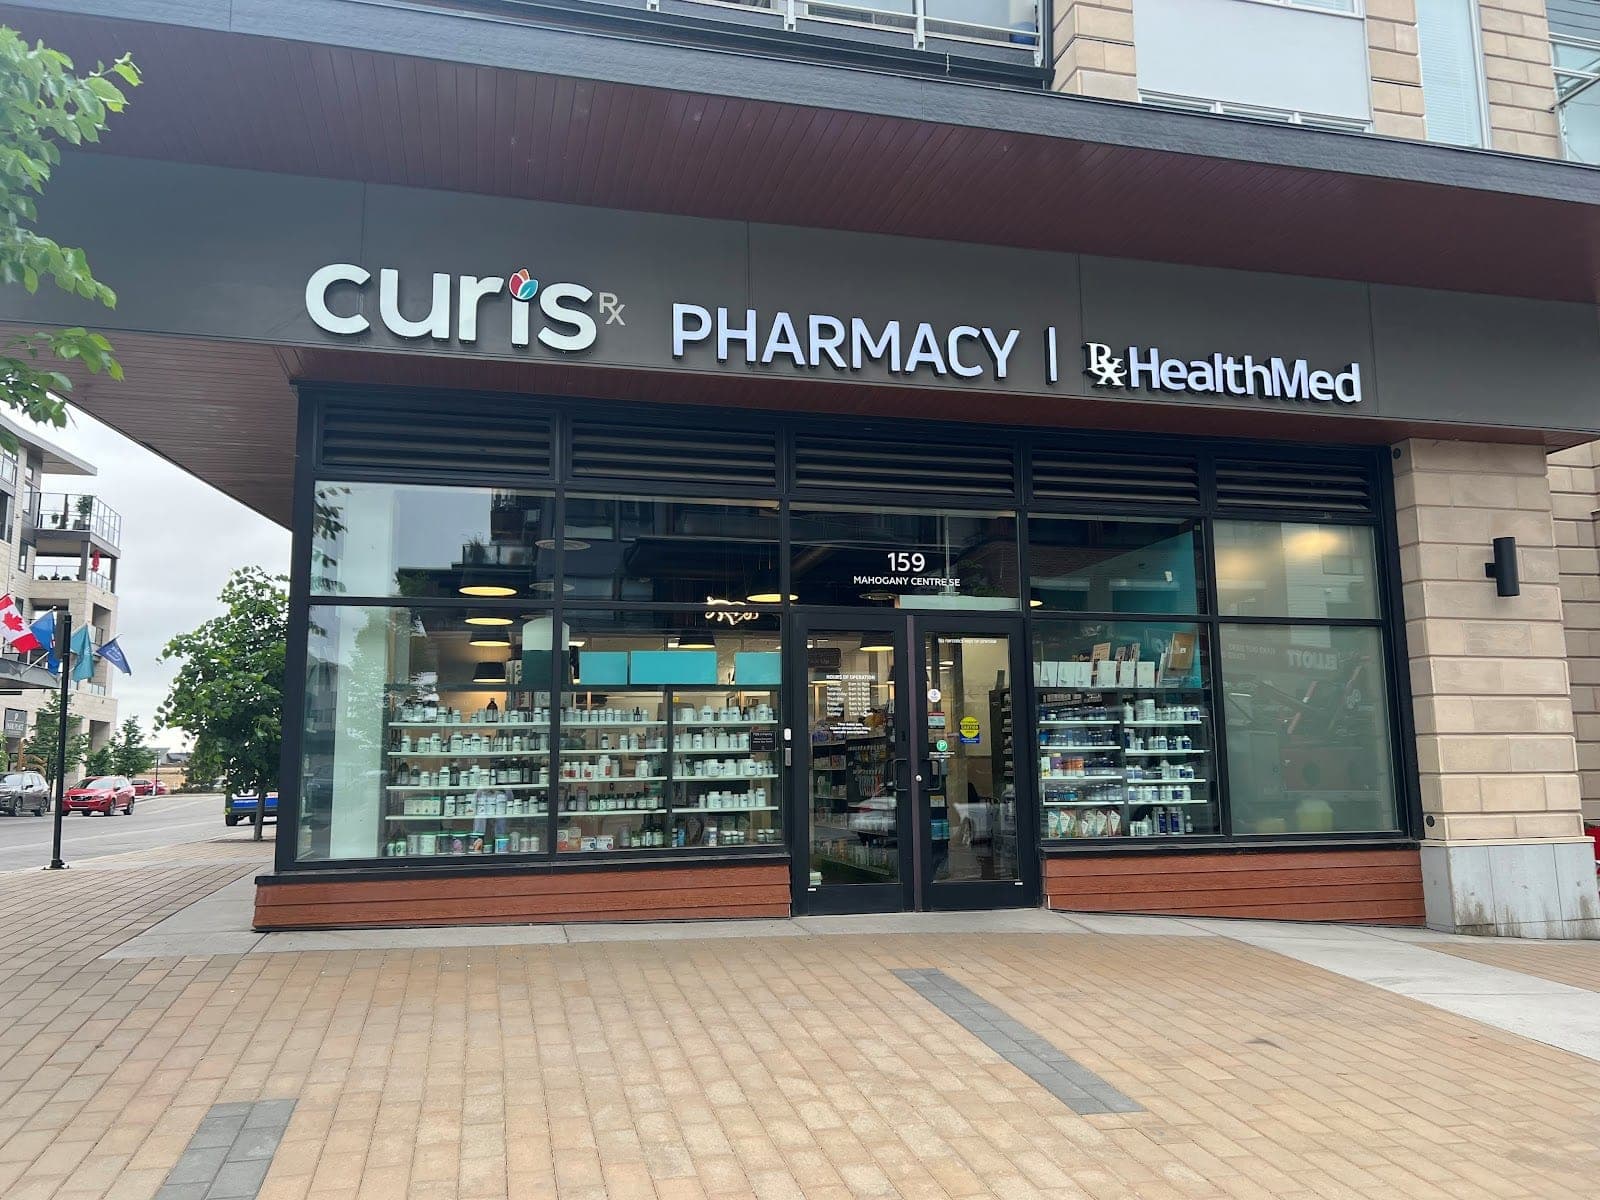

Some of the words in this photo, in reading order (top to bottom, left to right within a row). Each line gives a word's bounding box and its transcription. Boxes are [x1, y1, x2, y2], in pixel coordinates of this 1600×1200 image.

[306, 263, 597, 351] curis
[672, 302, 1020, 378] PHARMACY
[1128, 346, 1362, 403] HealthMed
[853, 575, 909, 586] MAHOGANY
[910, 577, 947, 587] CENTRE
[949, 578, 961, 587] SE
[887, 552, 926, 572] 159
